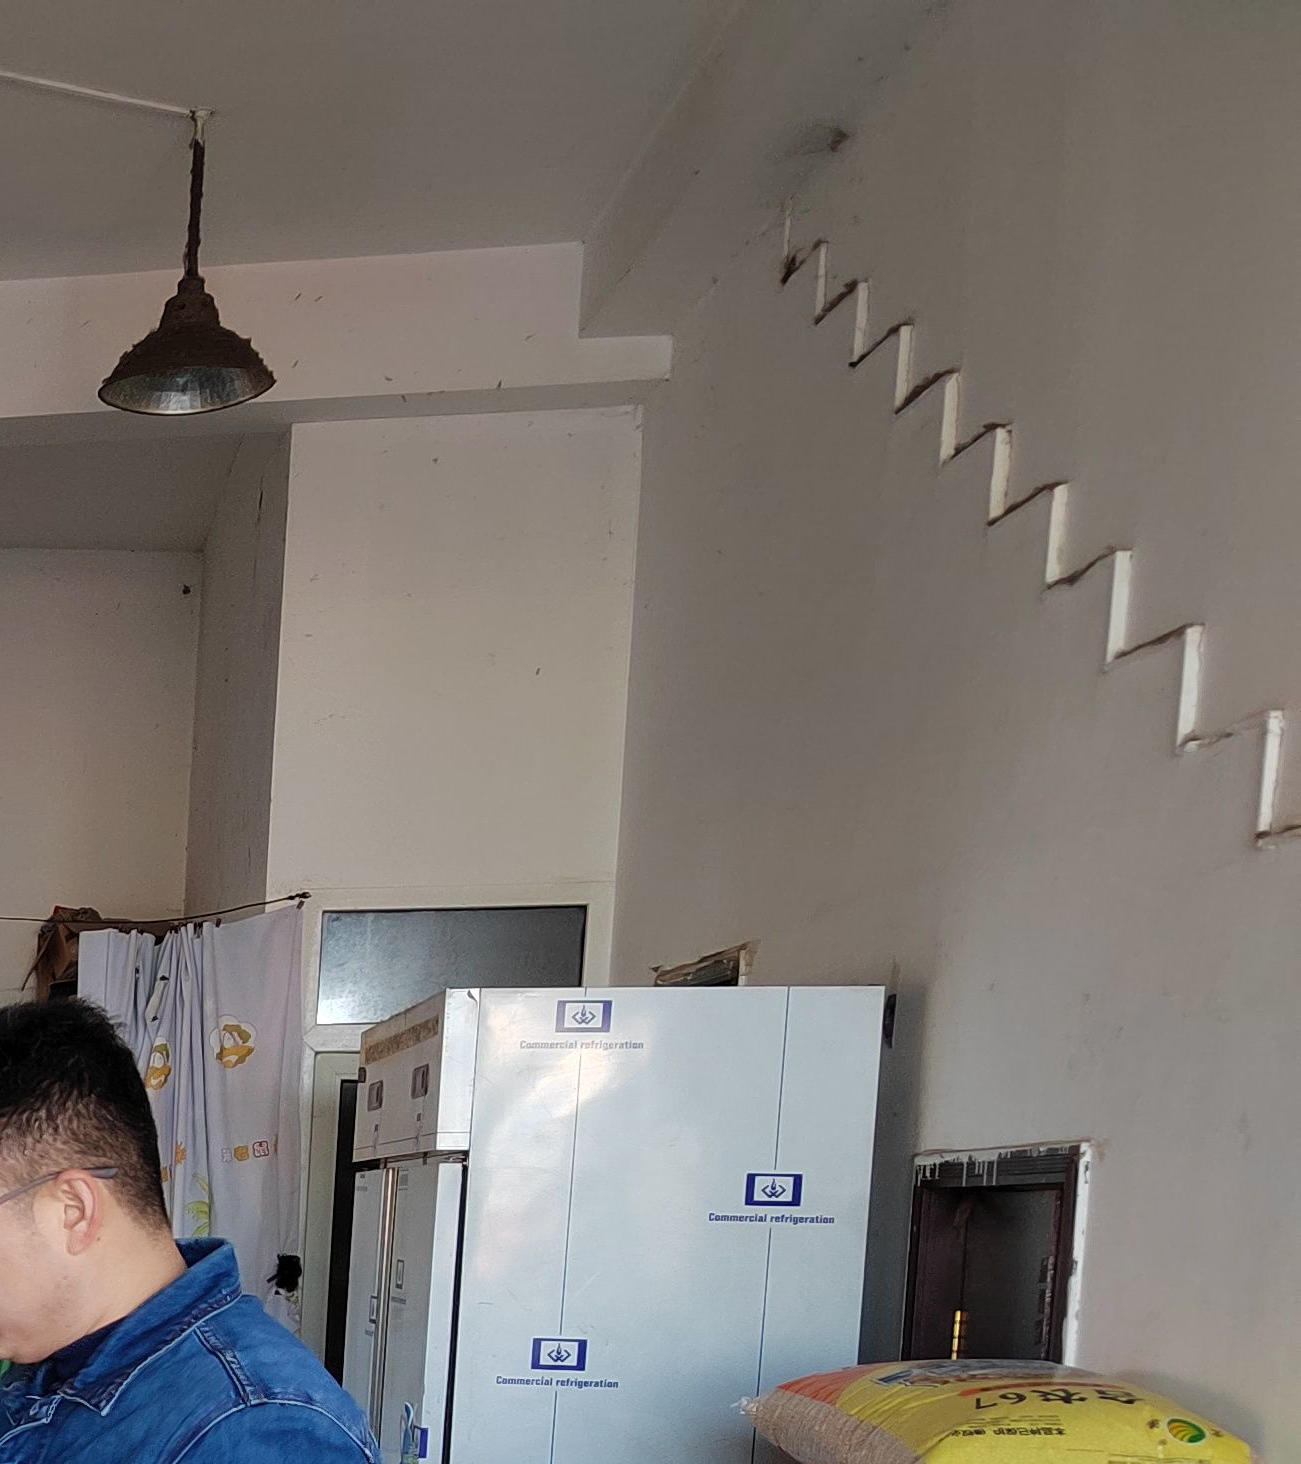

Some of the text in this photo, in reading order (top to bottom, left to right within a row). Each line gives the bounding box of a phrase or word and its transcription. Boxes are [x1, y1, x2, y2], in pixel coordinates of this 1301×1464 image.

[519, 1039, 645, 1052] Commercial refrigeration
[708, 1212, 836, 1226] Commercial refrigeration
[495, 1375, 620, 1390] Commercial refrigeration
